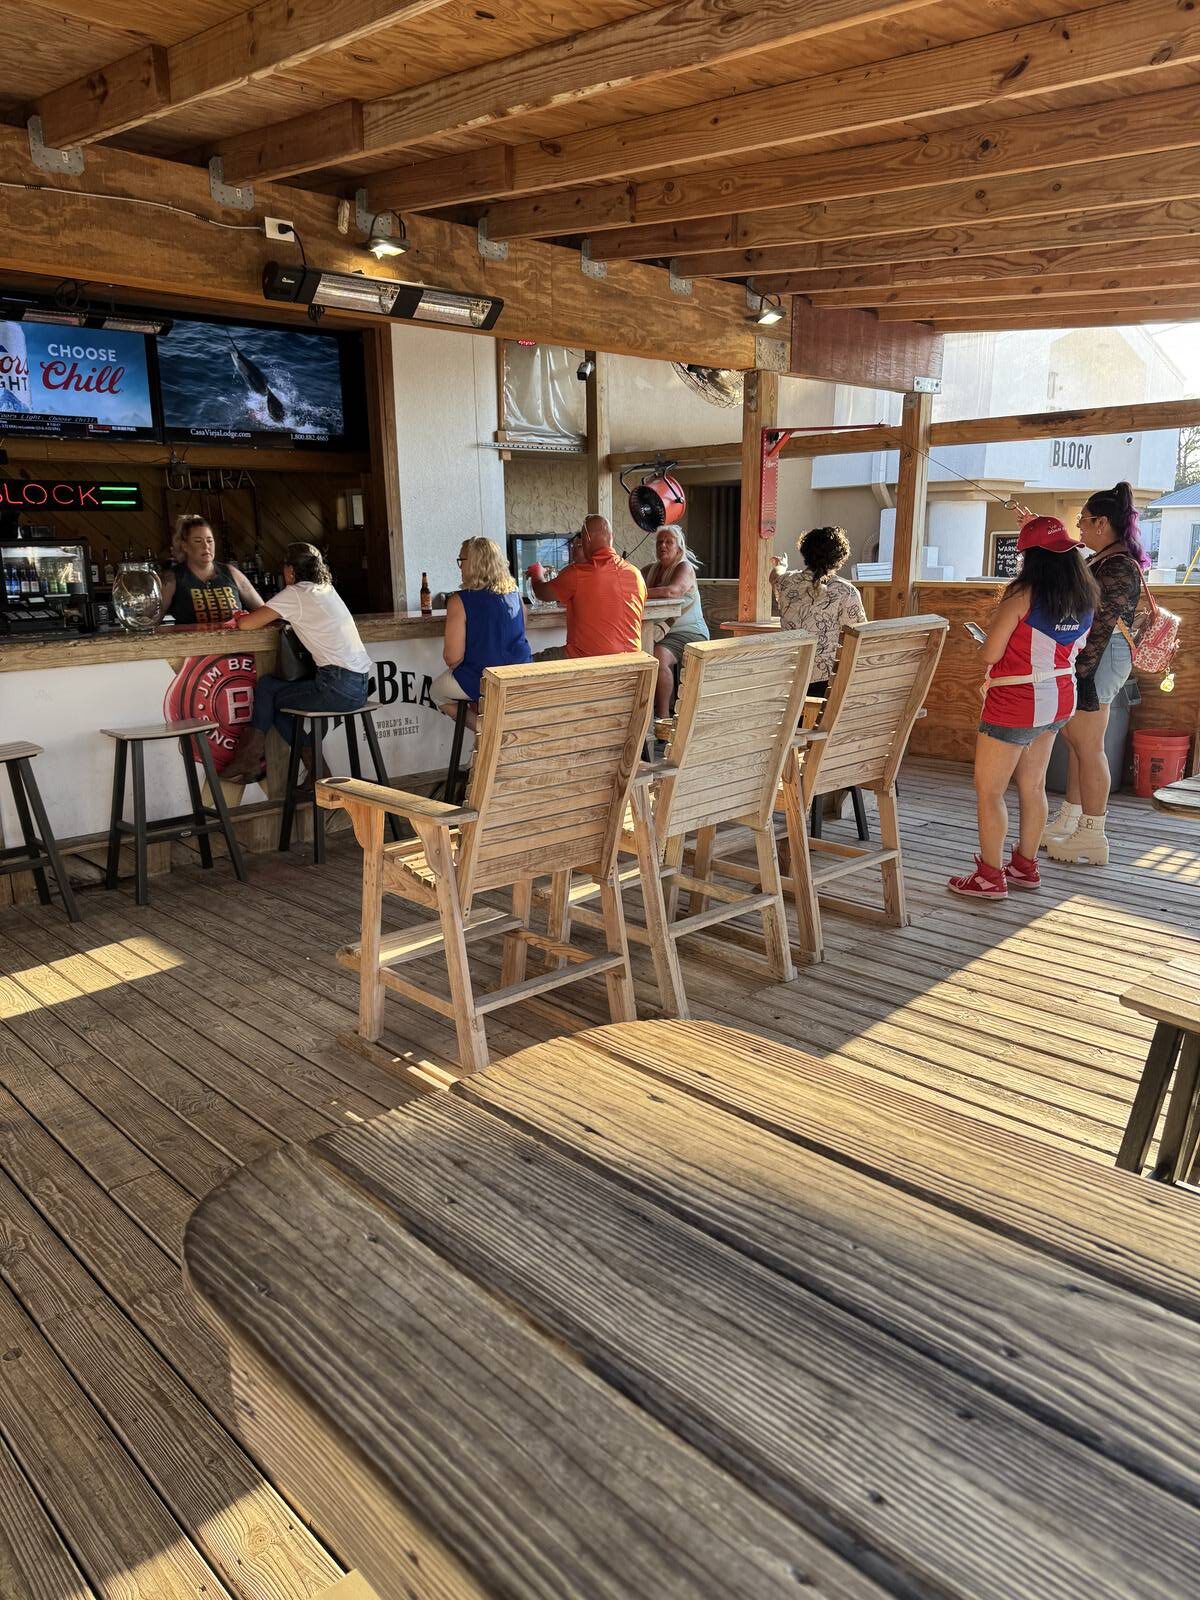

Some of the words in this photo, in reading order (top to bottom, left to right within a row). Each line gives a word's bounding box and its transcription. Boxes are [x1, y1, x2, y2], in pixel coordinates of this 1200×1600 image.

[48, 343, 117, 362] CHOOSE
[0, 375, 28, 391] GHT
[40, 360, 125, 394] Chill
[190, 429, 252, 438] CasaViejaLodge.com
[1052, 440, 1093, 470] BLOCK
[0, 483, 98, 506] LOCK
[191, 586, 236, 599] BEER
[193, 597, 239, 610] BEER
[195, 610, 232, 622] BEE
[198, 666, 223, 697] JIM
[227, 658, 257, 674] BE
[375, 660, 439, 710] BEA
[393, 726, 419, 736] WHISKEY
